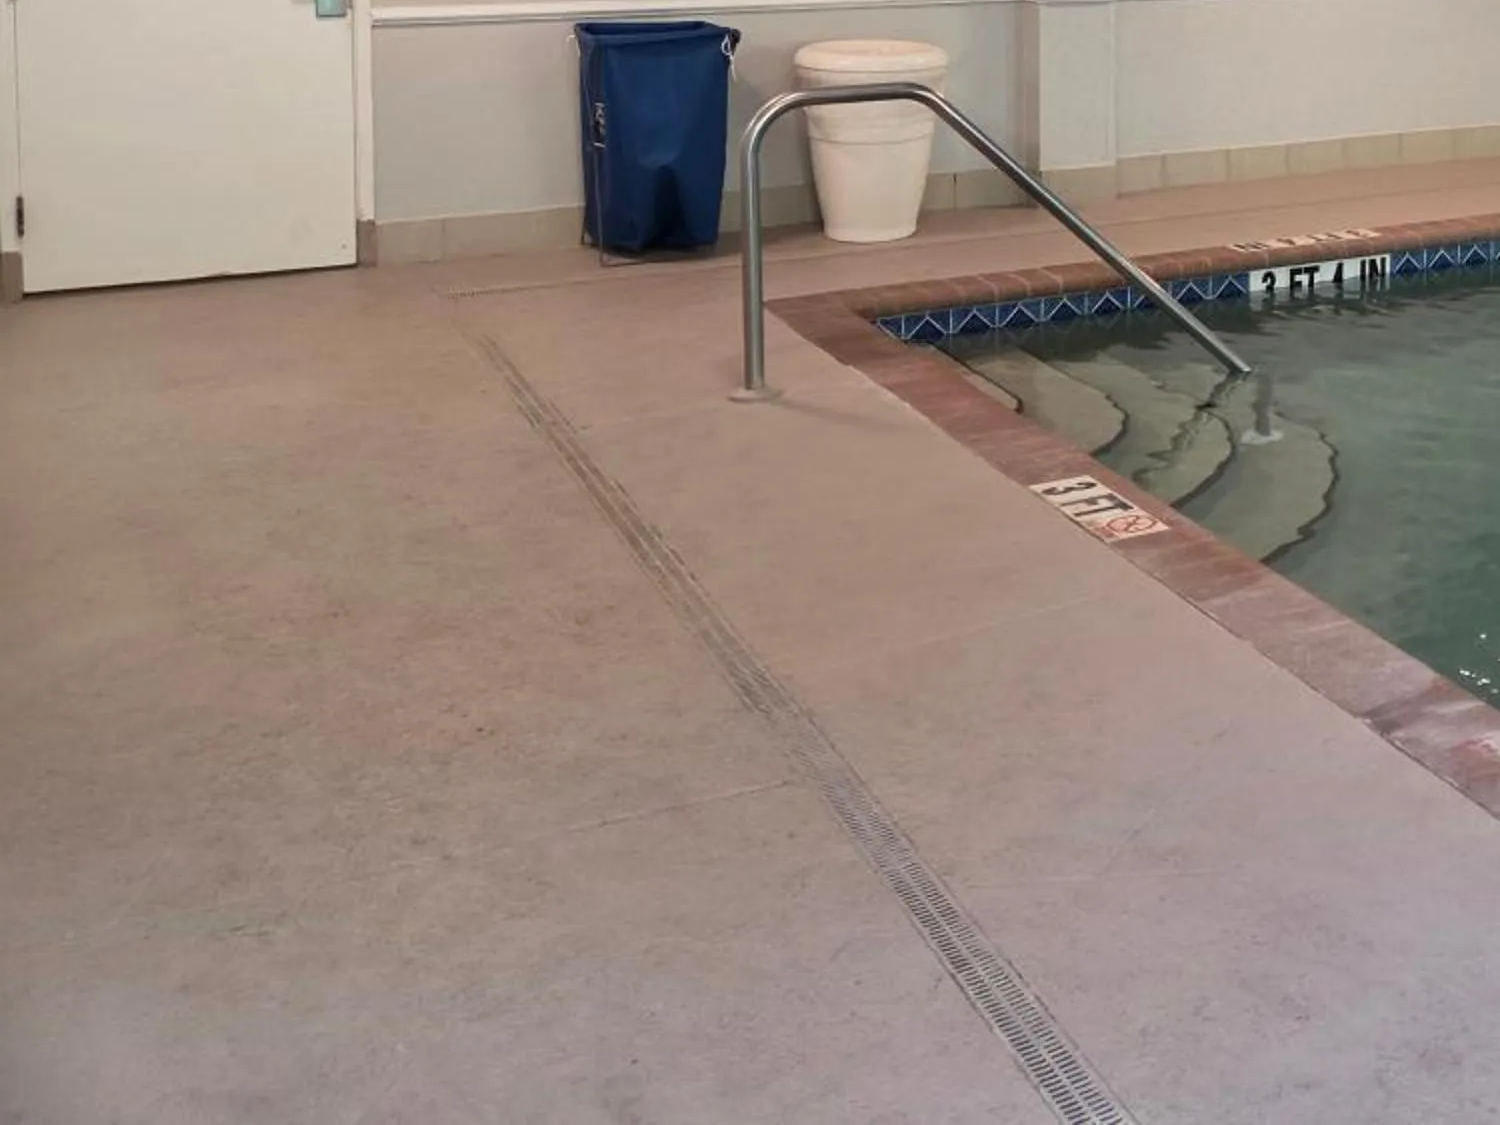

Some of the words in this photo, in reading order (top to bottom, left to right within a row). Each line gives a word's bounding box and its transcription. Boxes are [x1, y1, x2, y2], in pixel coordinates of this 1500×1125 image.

[1289, 265, 1320, 289] FT
[1360, 257, 1386, 281] IN
[1042, 481, 1097, 496] 3
[1060, 493, 1135, 517] FT
